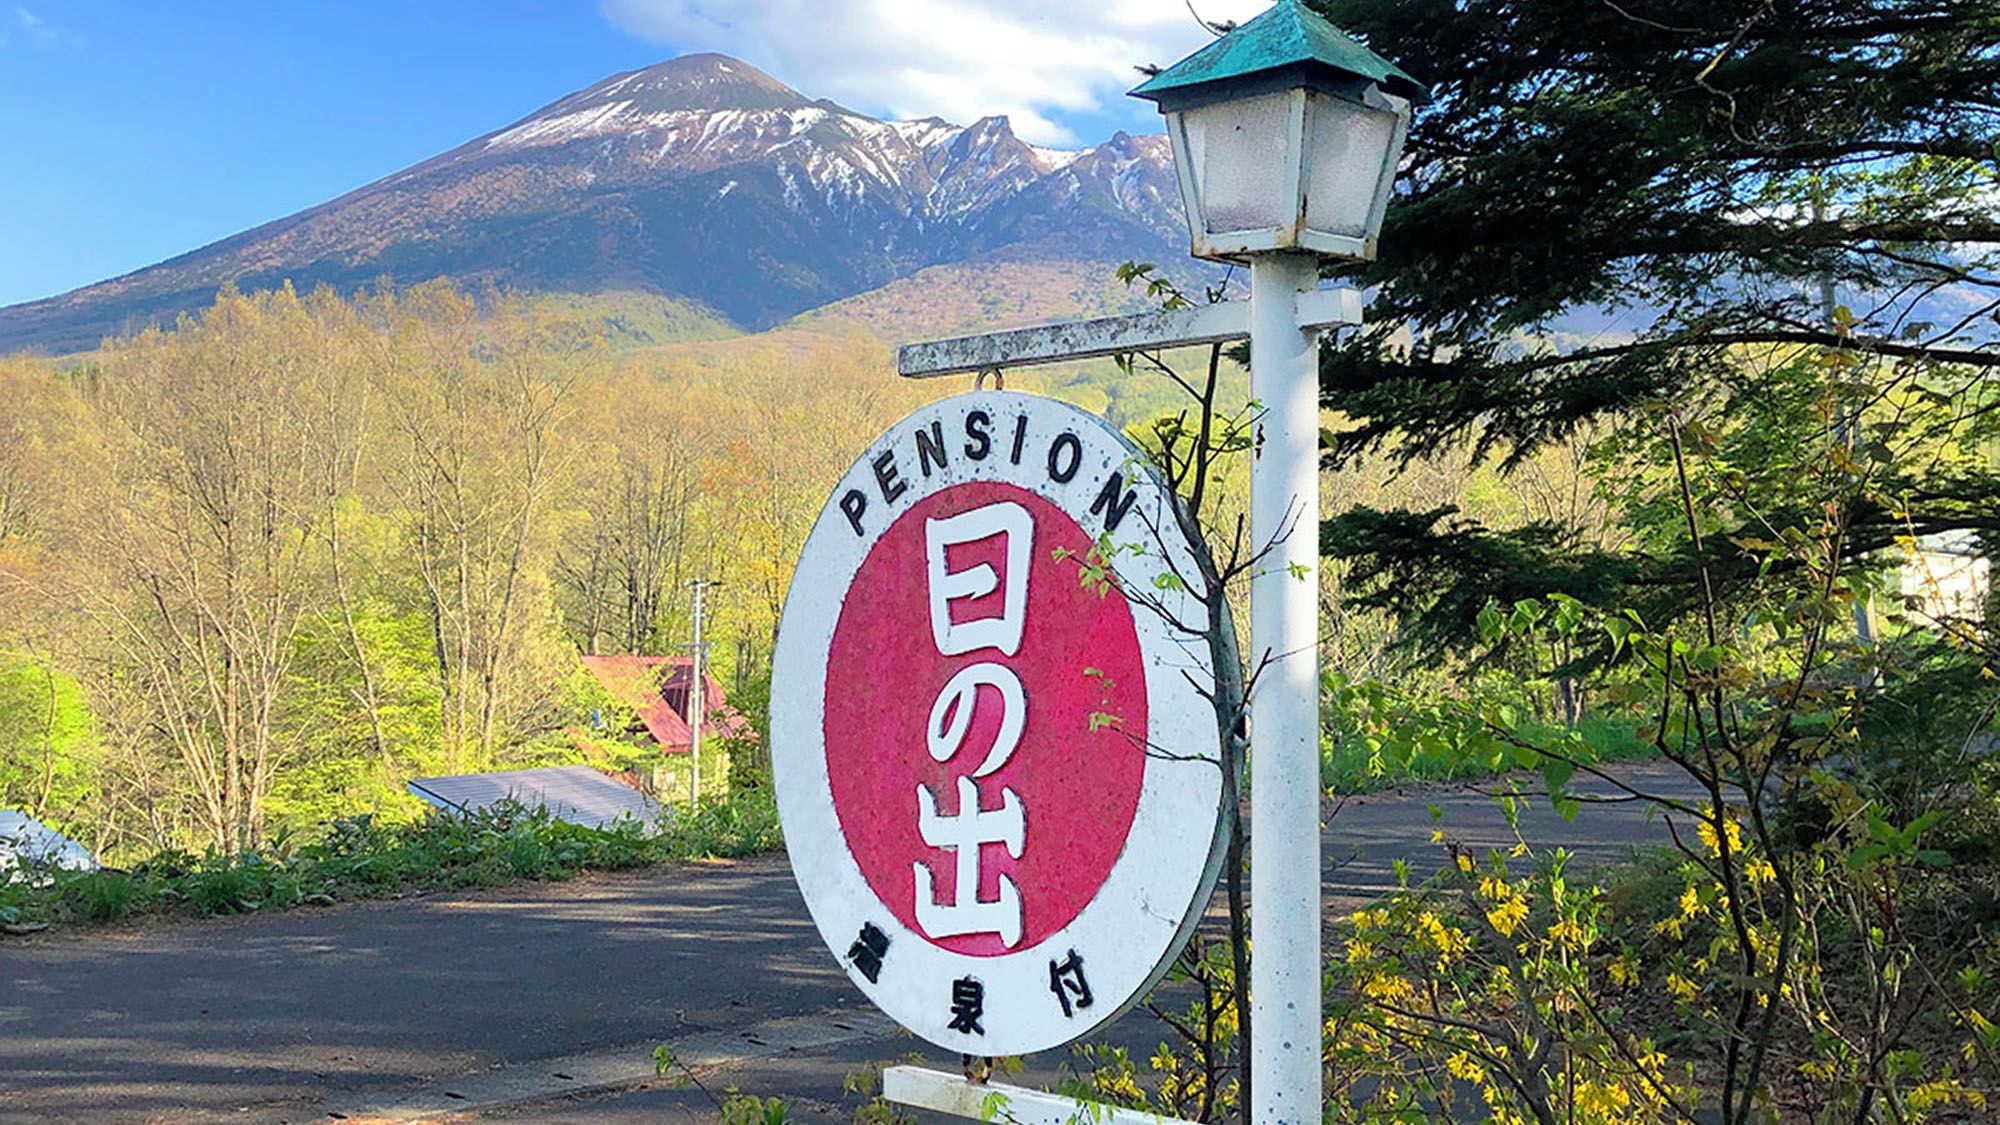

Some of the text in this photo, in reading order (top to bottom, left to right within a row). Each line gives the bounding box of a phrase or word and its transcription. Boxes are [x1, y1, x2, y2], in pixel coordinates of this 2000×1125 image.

[839, 410, 1137, 536] PENSION
[913, 501, 1034, 948] 日の出
